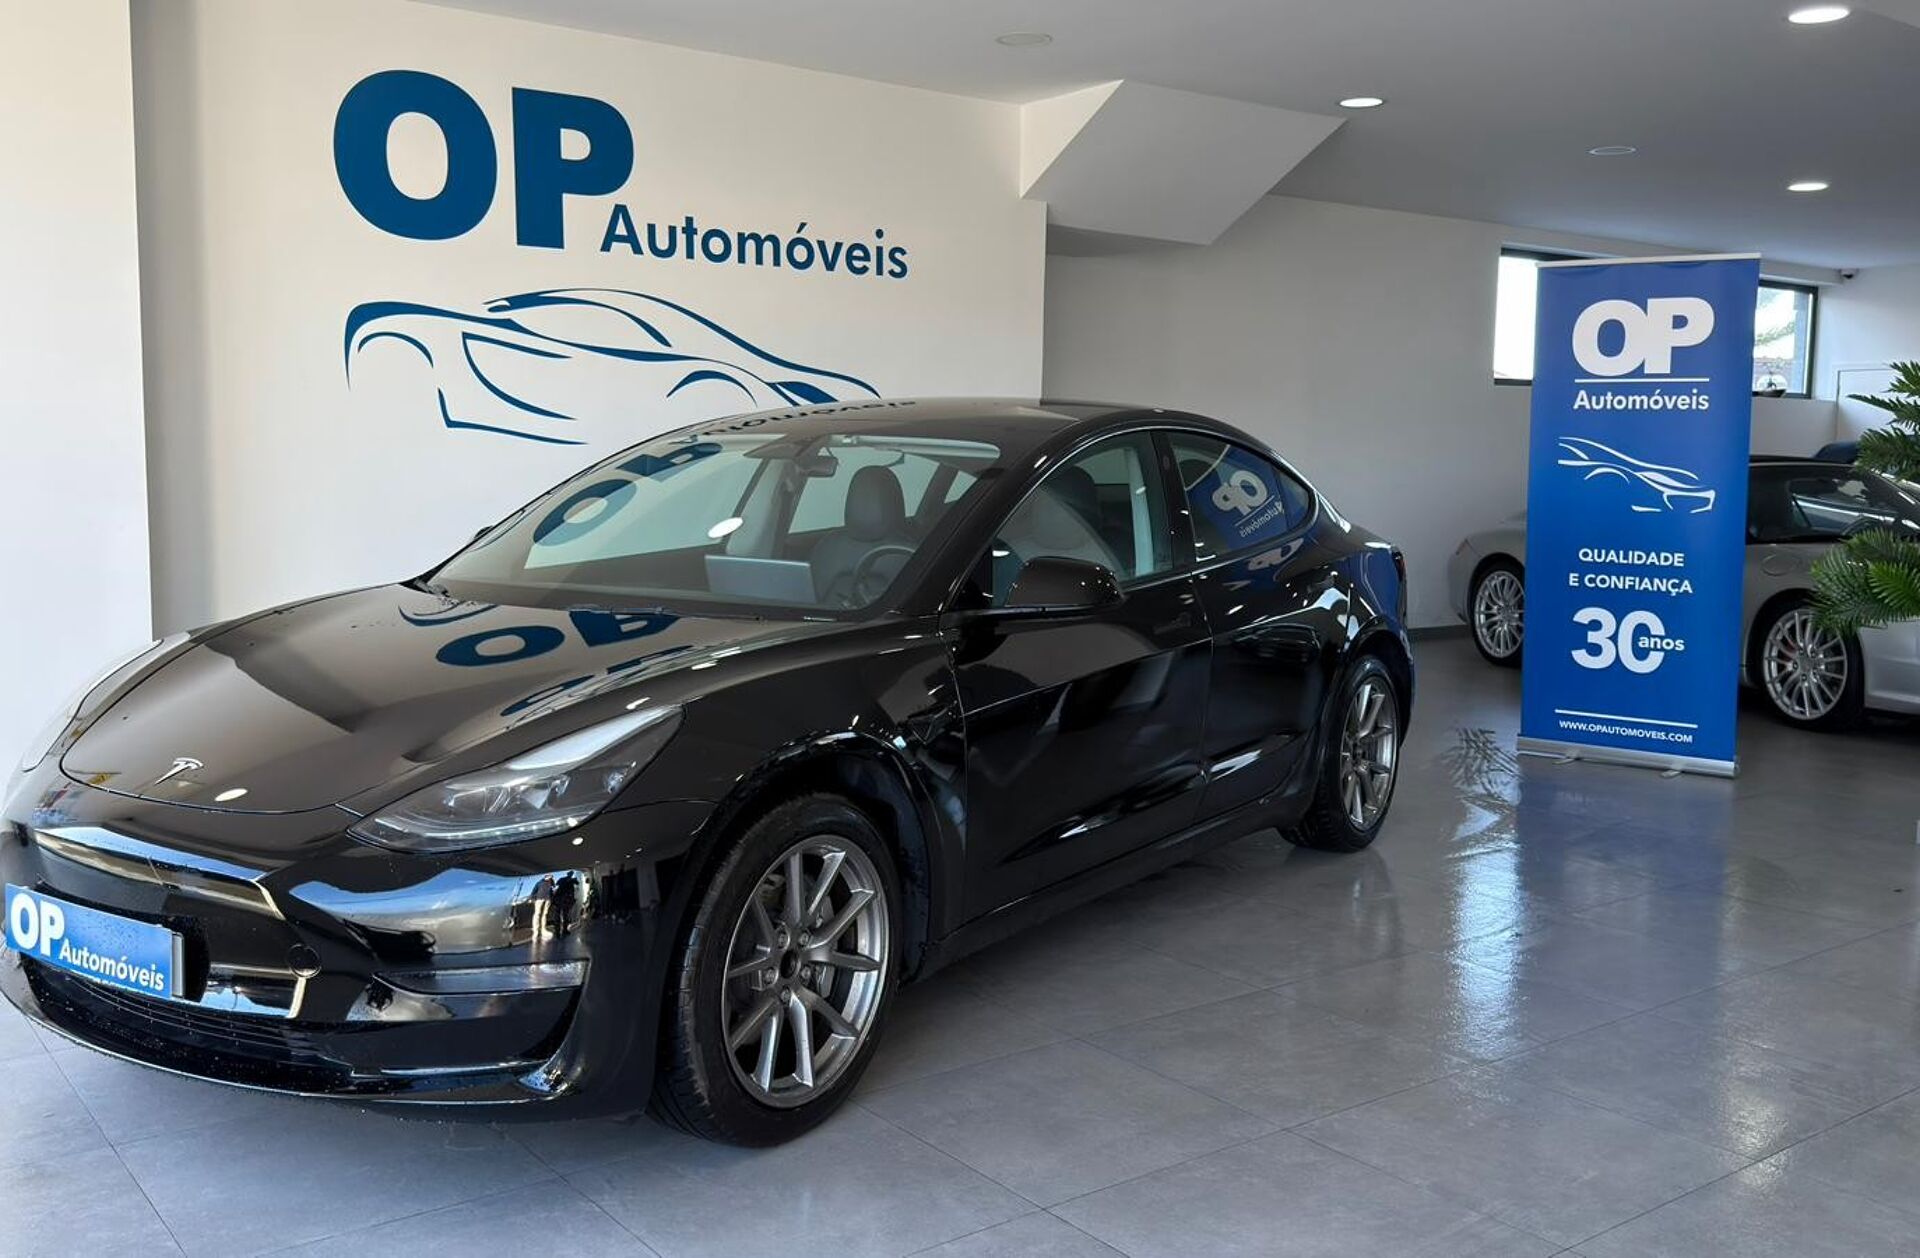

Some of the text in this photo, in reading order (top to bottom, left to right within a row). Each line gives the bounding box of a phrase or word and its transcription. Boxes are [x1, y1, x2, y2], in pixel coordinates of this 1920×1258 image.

[333, 69, 909, 280] OP Automóveis
[1572, 297, 1715, 377] OP
[1573, 389, 1710, 411] Automóveis
[1578, 548, 1685, 567] QUALIDADE
[1568, 572, 1693, 596] E CONFIANÇA
[1571, 606, 1685, 675] 30 anos
[1558, 719, 1693, 744] WWW.OPAUTOMOVEIS.COM
[10, 892, 165, 992] OP Automóveis
